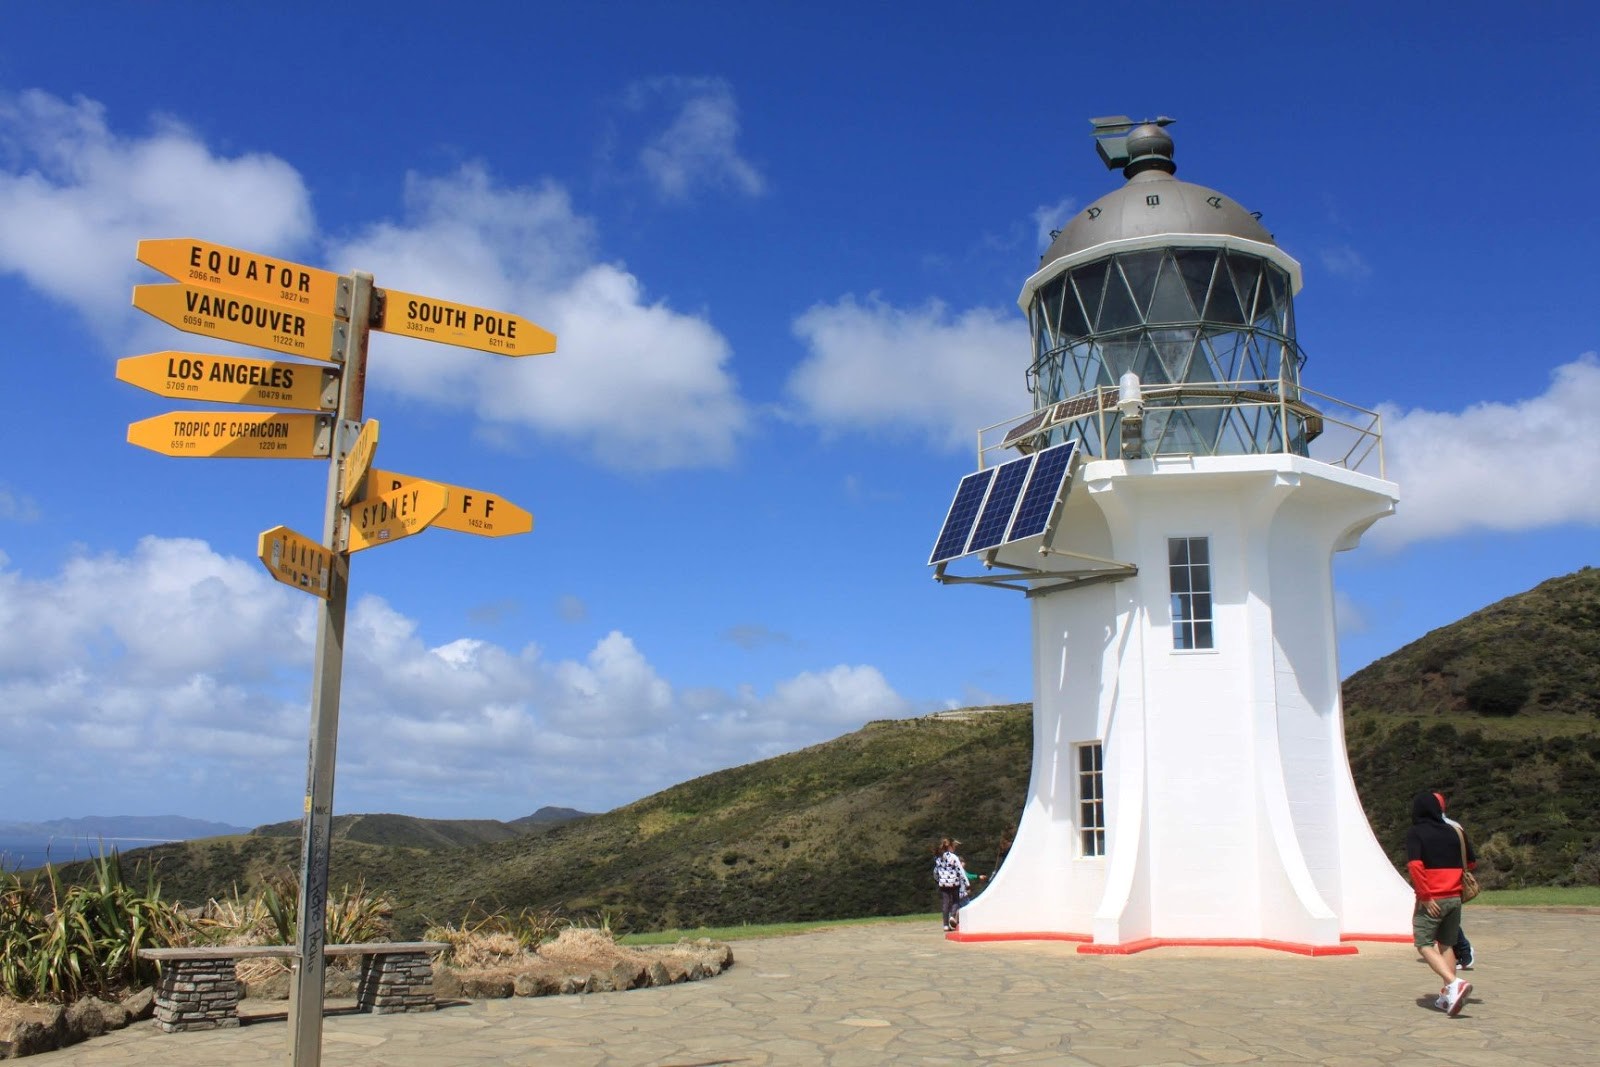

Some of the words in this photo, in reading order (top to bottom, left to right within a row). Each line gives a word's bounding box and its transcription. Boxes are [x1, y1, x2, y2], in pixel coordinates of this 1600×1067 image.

[189, 269, 208, 281] 2066
[209, 275, 221, 284] nm
[190, 246, 311, 293] EQUATOR
[280, 290, 297, 302] 3827
[299, 293, 310, 304] km
[186, 291, 306, 337] VANCOUVER
[407, 300, 466, 329] SOUTH
[473, 313, 517, 339] POLE
[183, 315, 202, 327] 6059
[204, 321, 216, 329] nm
[424, 326, 435, 334] nm
[273, 335, 293, 347] 11222
[294, 337, 305, 349] km
[489, 338, 503, 348] 6211
[506, 341, 516, 350] km
[167, 358, 204, 381] LOS
[209, 362, 294, 389] ANGELES
[166, 381, 185, 391] 5709
[186, 384, 199, 392] nm
[258, 390, 280, 400] 10479
[281, 392, 293, 401] km
[174, 421, 210, 437] TROPIC
[213, 422, 227, 437] OF
[230, 422, 289, 438] CAPRICORN
[171, 440, 184, 449] 659
[185, 441, 196, 449] nm
[259, 442, 276, 450] 1220
[277, 441, 287, 450] km
[362, 490, 419, 529] SYDNEY
[468, 518, 483, 528] 1452
[483, 520, 494, 530] km
[283, 535, 322, 575] TOKYO
